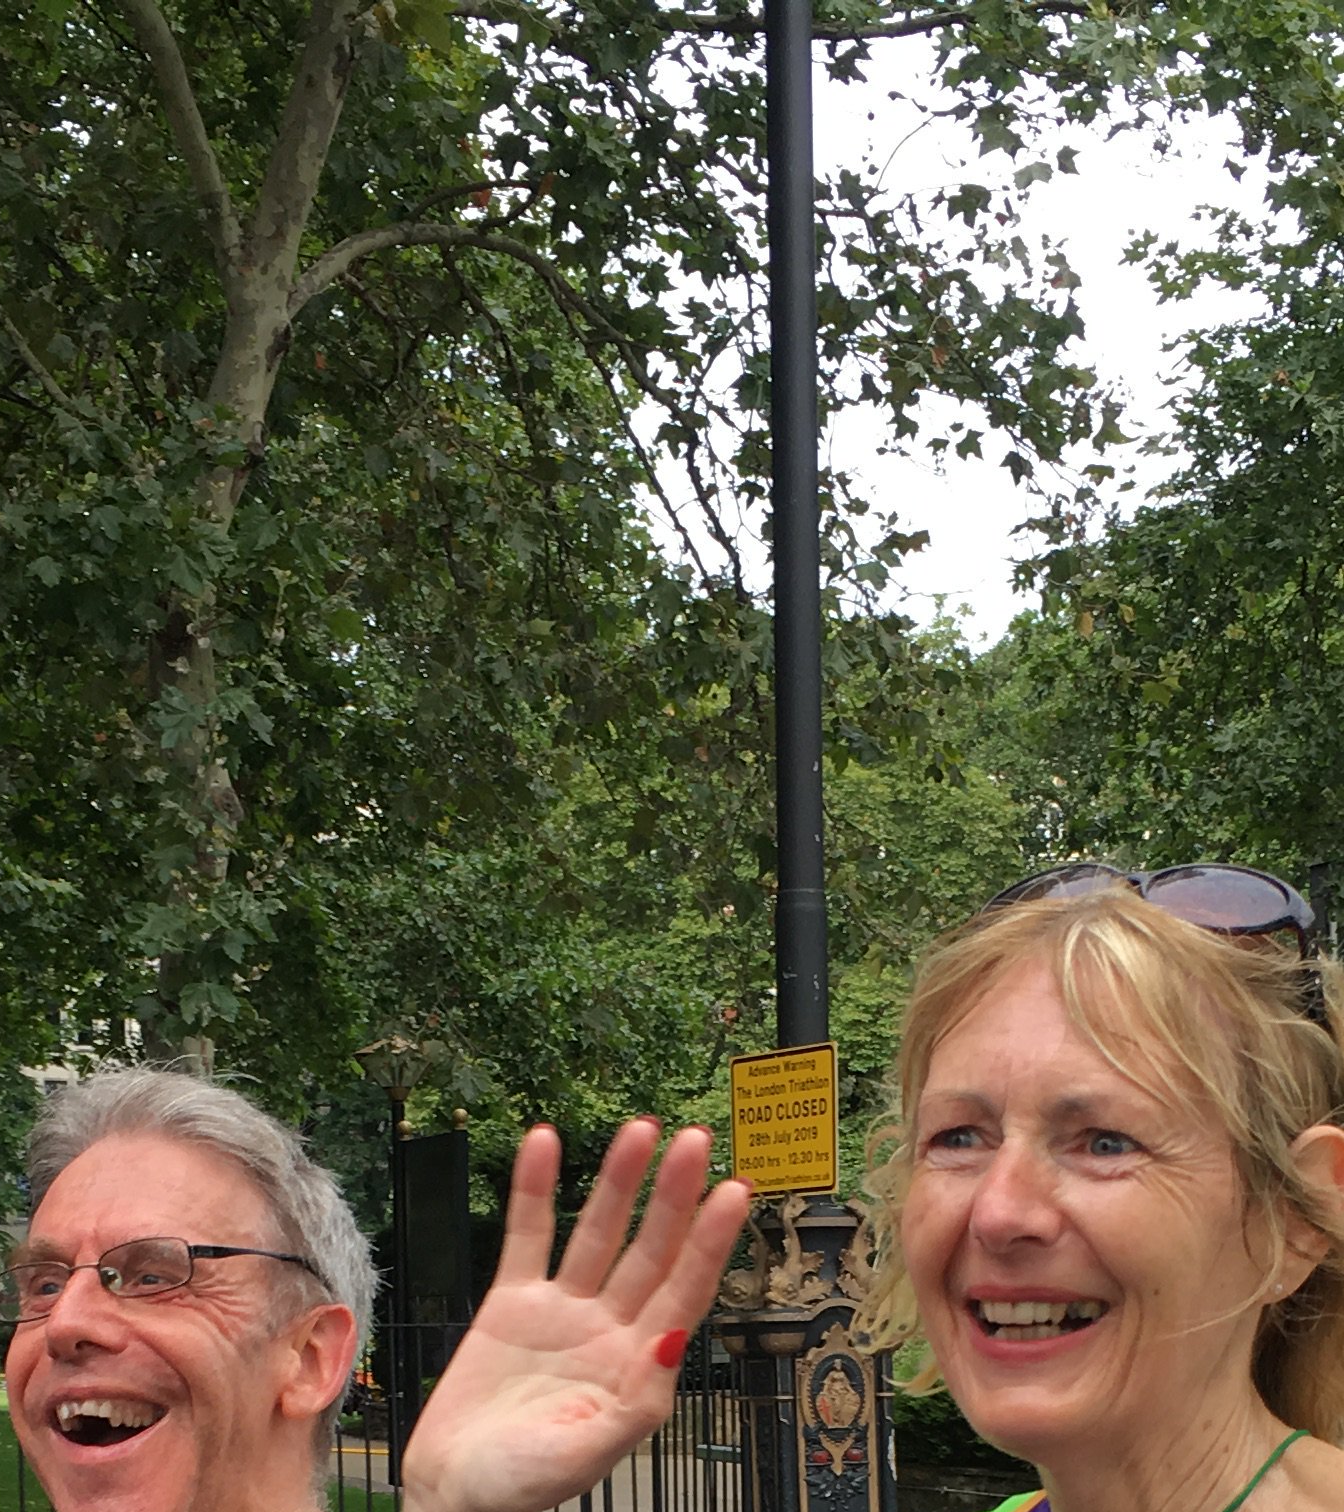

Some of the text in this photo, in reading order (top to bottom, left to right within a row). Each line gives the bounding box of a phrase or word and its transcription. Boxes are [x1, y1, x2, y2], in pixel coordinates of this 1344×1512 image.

[749, 1059, 816, 1077] Advance Warning
[736, 1077, 829, 1099] The London Triathlon
[738, 1098, 827, 1126] ROAD CLOSED
[749, 1126, 818, 1147] 28th July 2019
[767, 1155, 781, 1168] hrs
[815, 1149, 830, 1163] hrs
